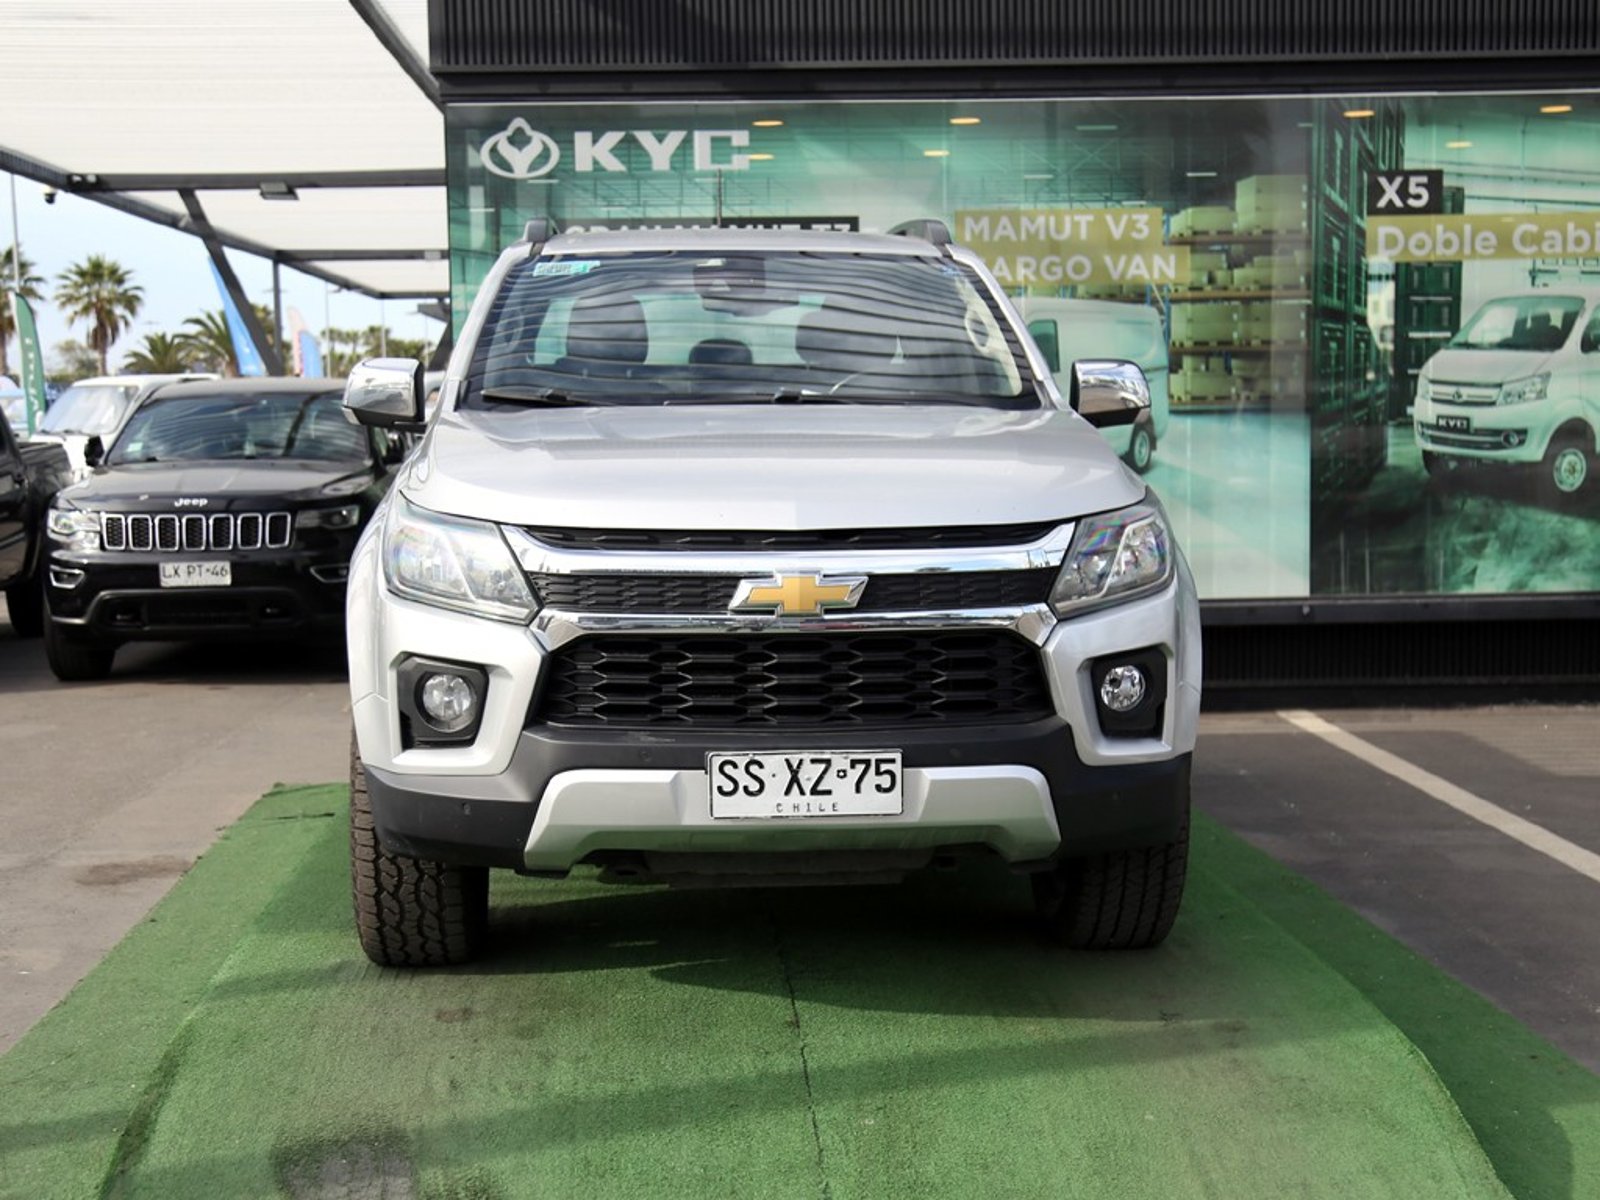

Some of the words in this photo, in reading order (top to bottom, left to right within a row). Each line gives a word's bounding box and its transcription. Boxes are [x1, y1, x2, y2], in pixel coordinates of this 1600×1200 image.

[574, 130, 750, 172] KYC
[1376, 175, 1430, 209] X5
[964, 213, 1094, 243] MAMUT
[1105, 212, 1150, 240] V3
[1377, 223, 1498, 258] Doble
[981, 254, 1093, 282] ARGO
[1104, 253, 1176, 281] VAN
[174, 497, 208, 507] Jeep
[775, 801, 839, 813] CHILE
